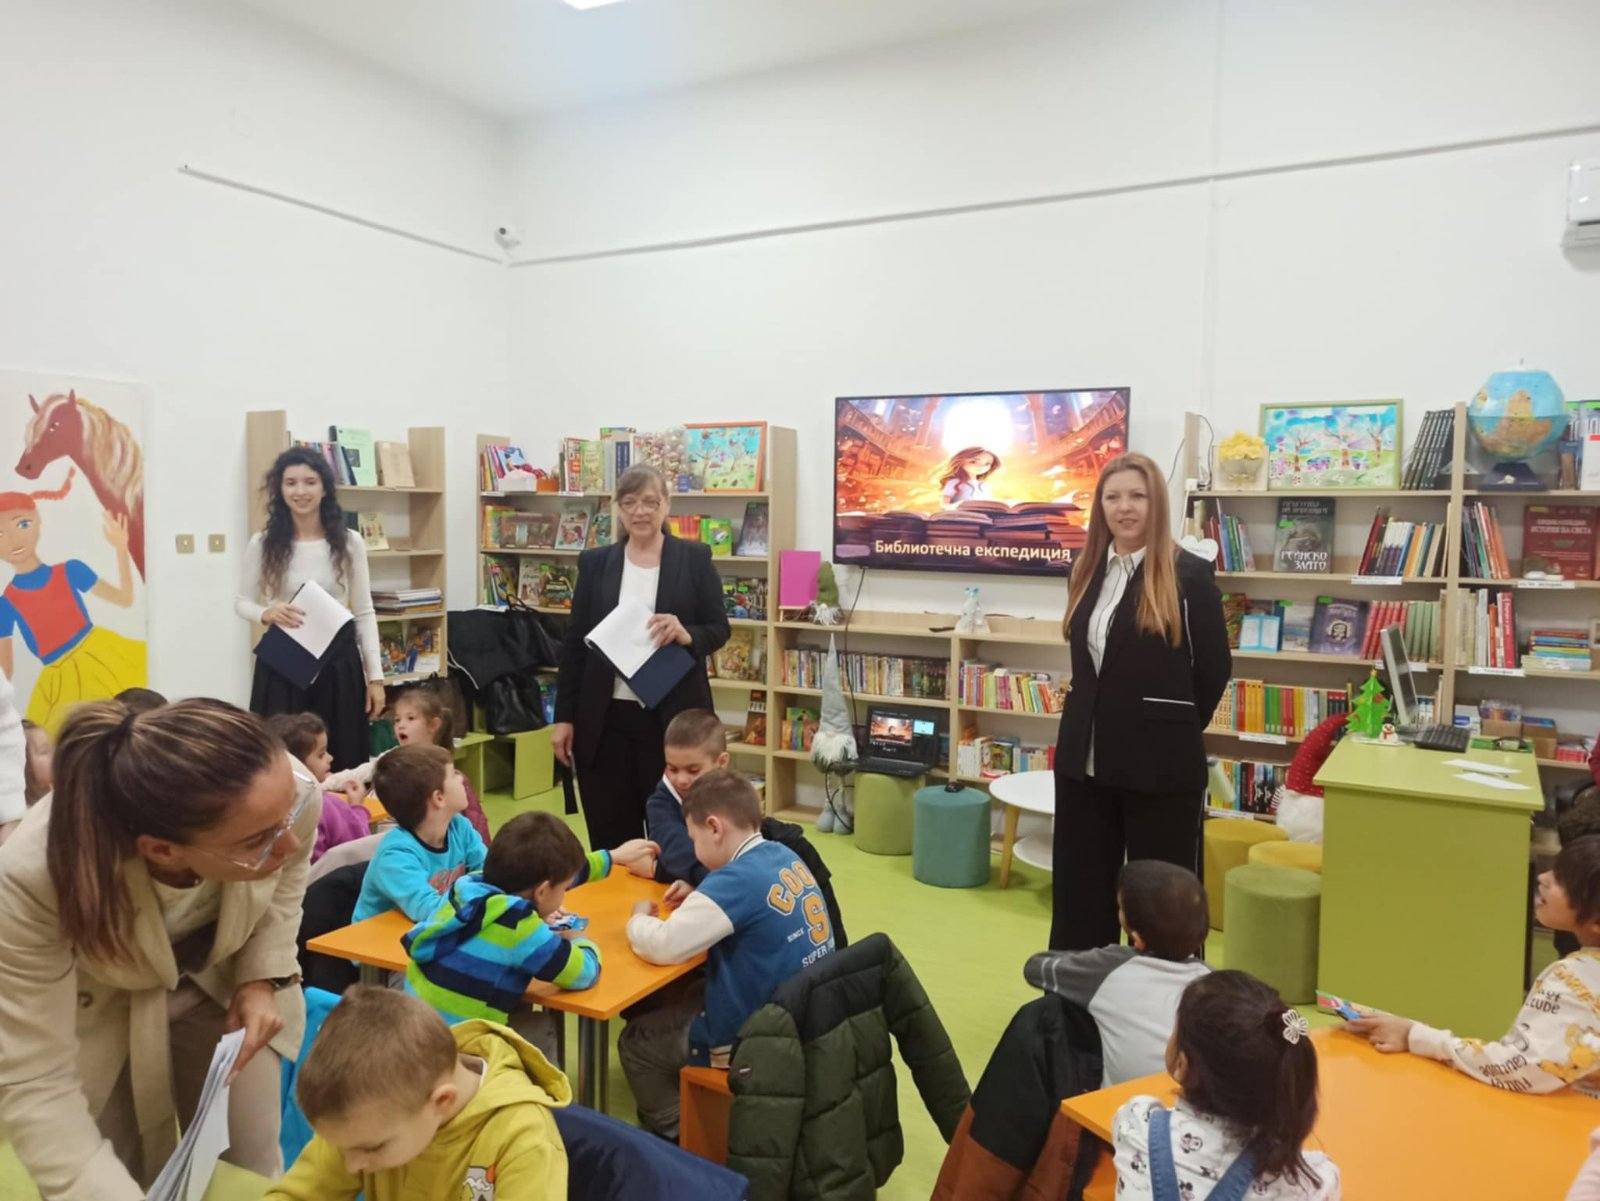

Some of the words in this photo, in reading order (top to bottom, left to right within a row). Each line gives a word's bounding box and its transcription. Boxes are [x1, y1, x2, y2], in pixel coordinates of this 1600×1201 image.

[875, 540, 970, 557] Библиотечна
[974, 545, 1072, 562] експедиция
[1294, 560, 1327, 571] ЗЛАТО
[767, 861, 816, 916] COO
[801, 945, 828, 968] SUPER
